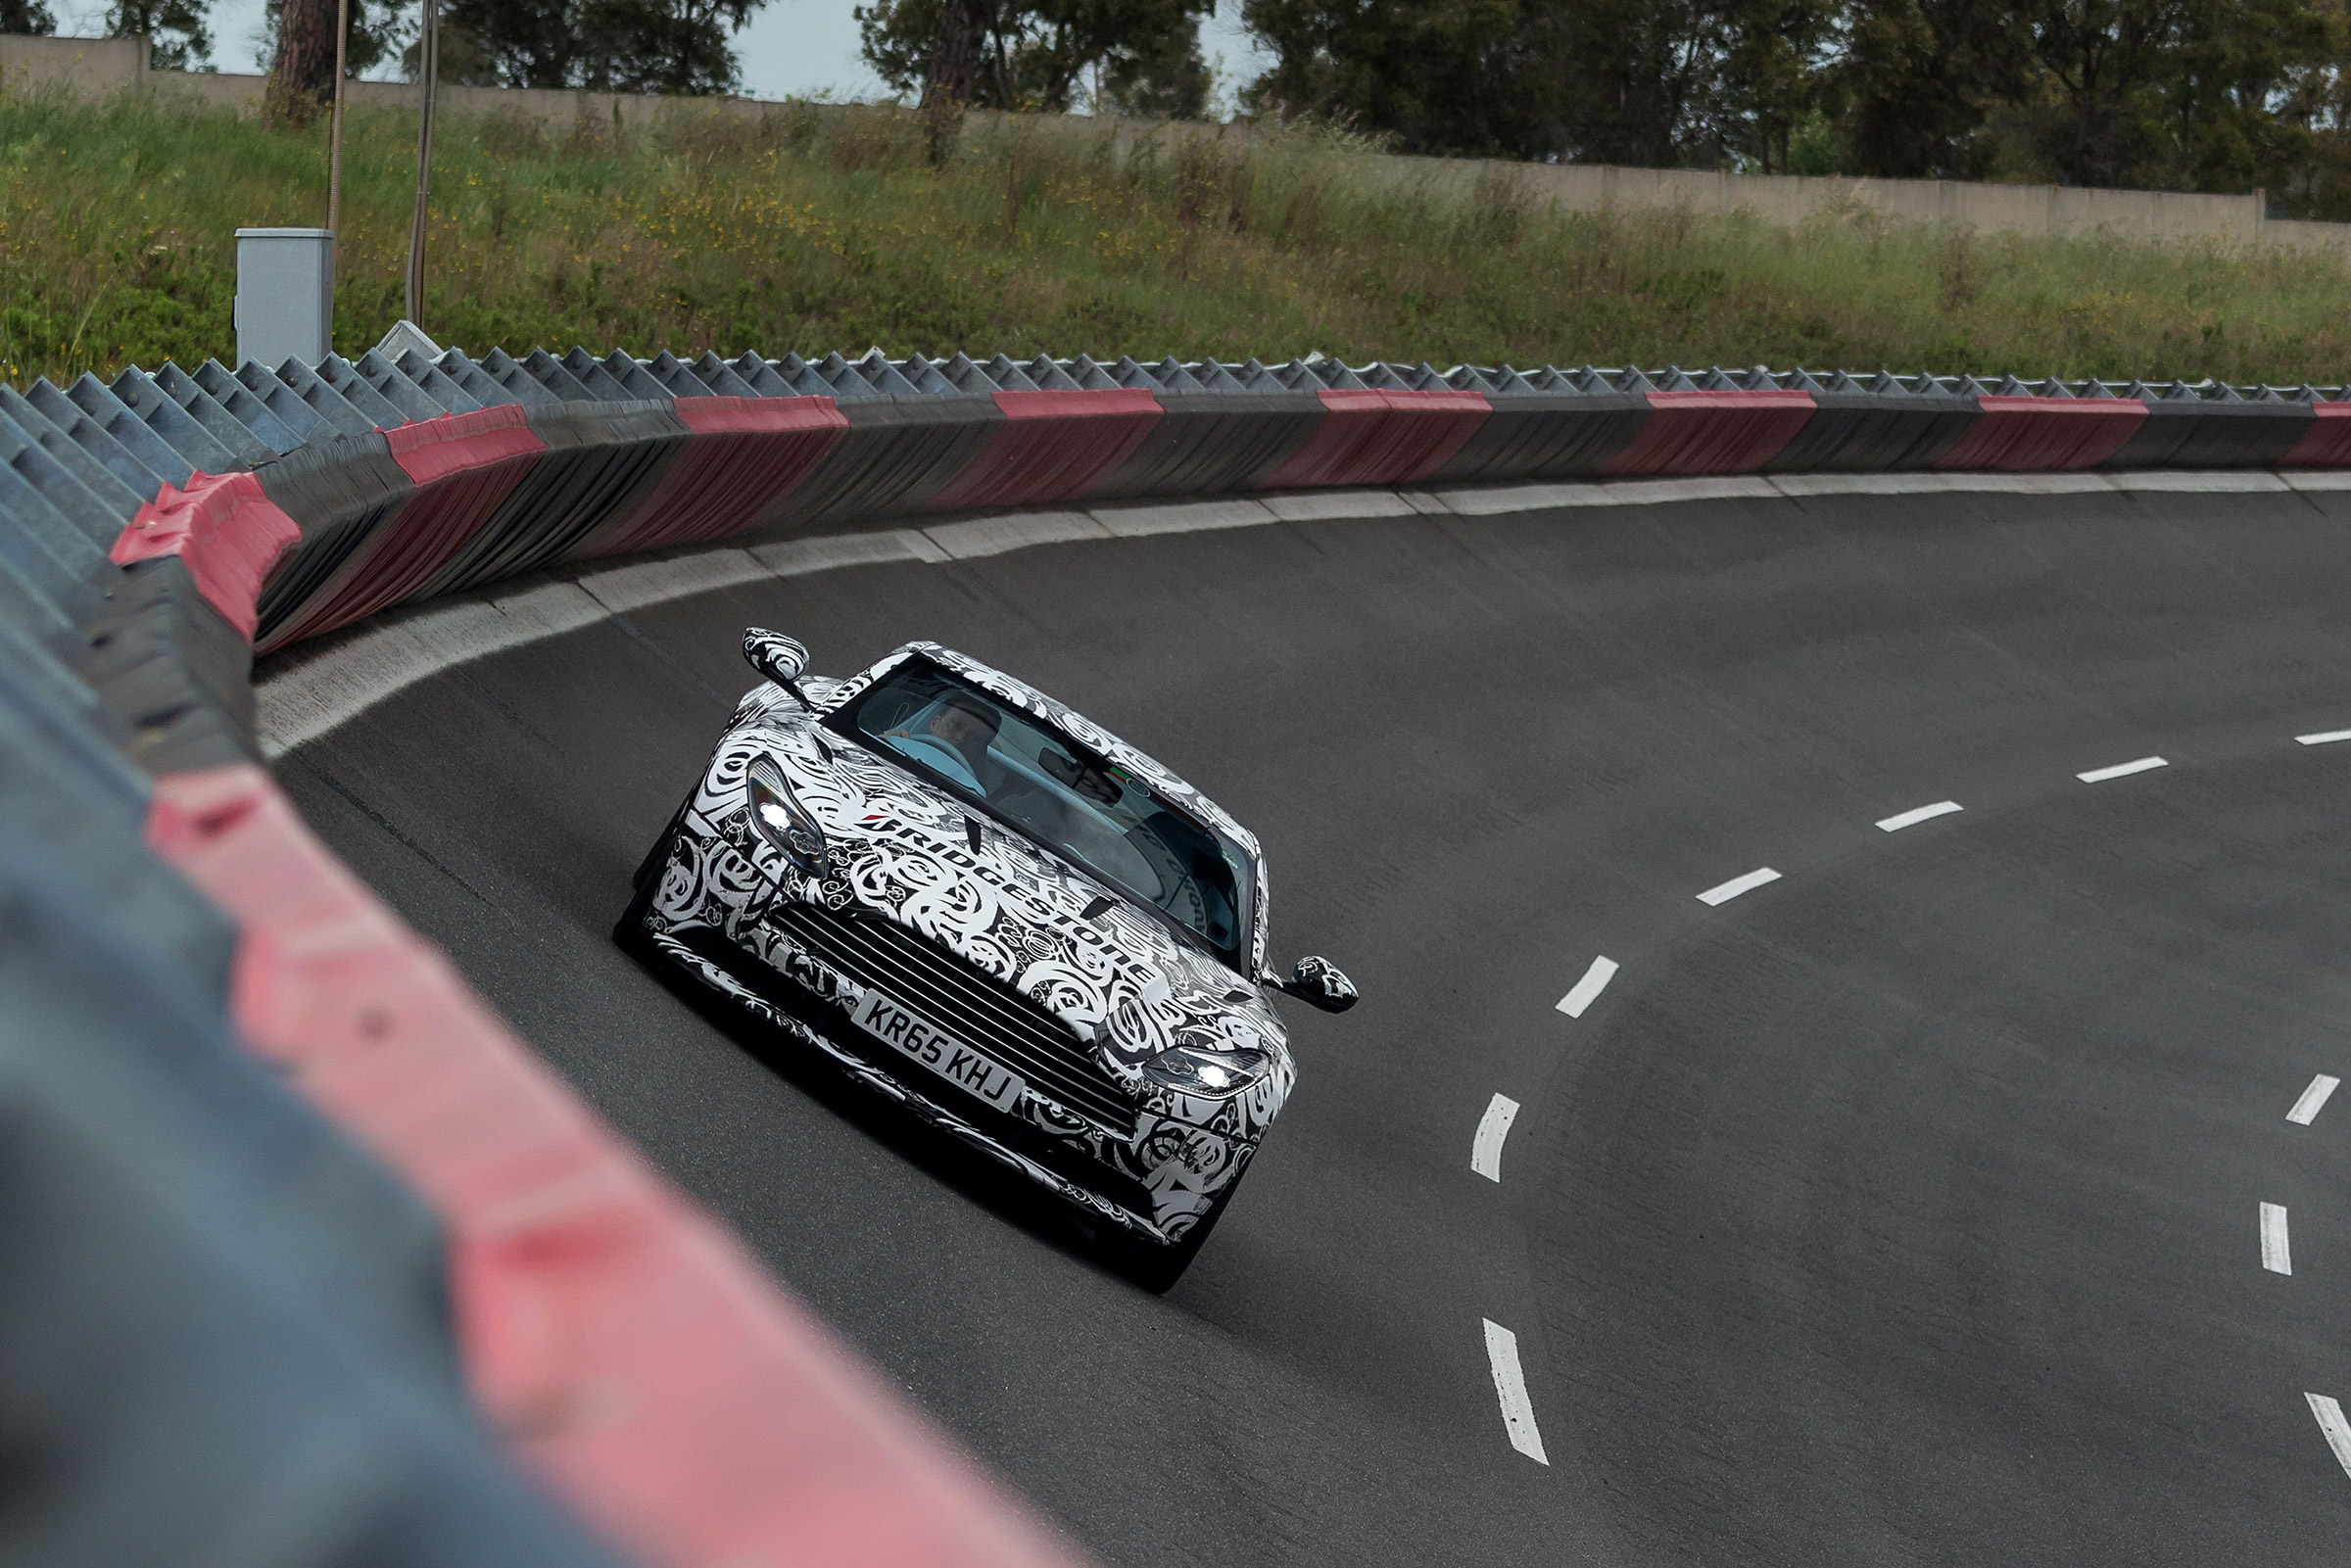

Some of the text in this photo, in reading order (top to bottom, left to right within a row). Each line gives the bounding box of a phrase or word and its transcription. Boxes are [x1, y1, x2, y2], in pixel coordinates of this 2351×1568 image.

[853, 815, 1156, 980] BRIDGESTONE
[864, 998, 1012, 1101] KR65 KHJ
